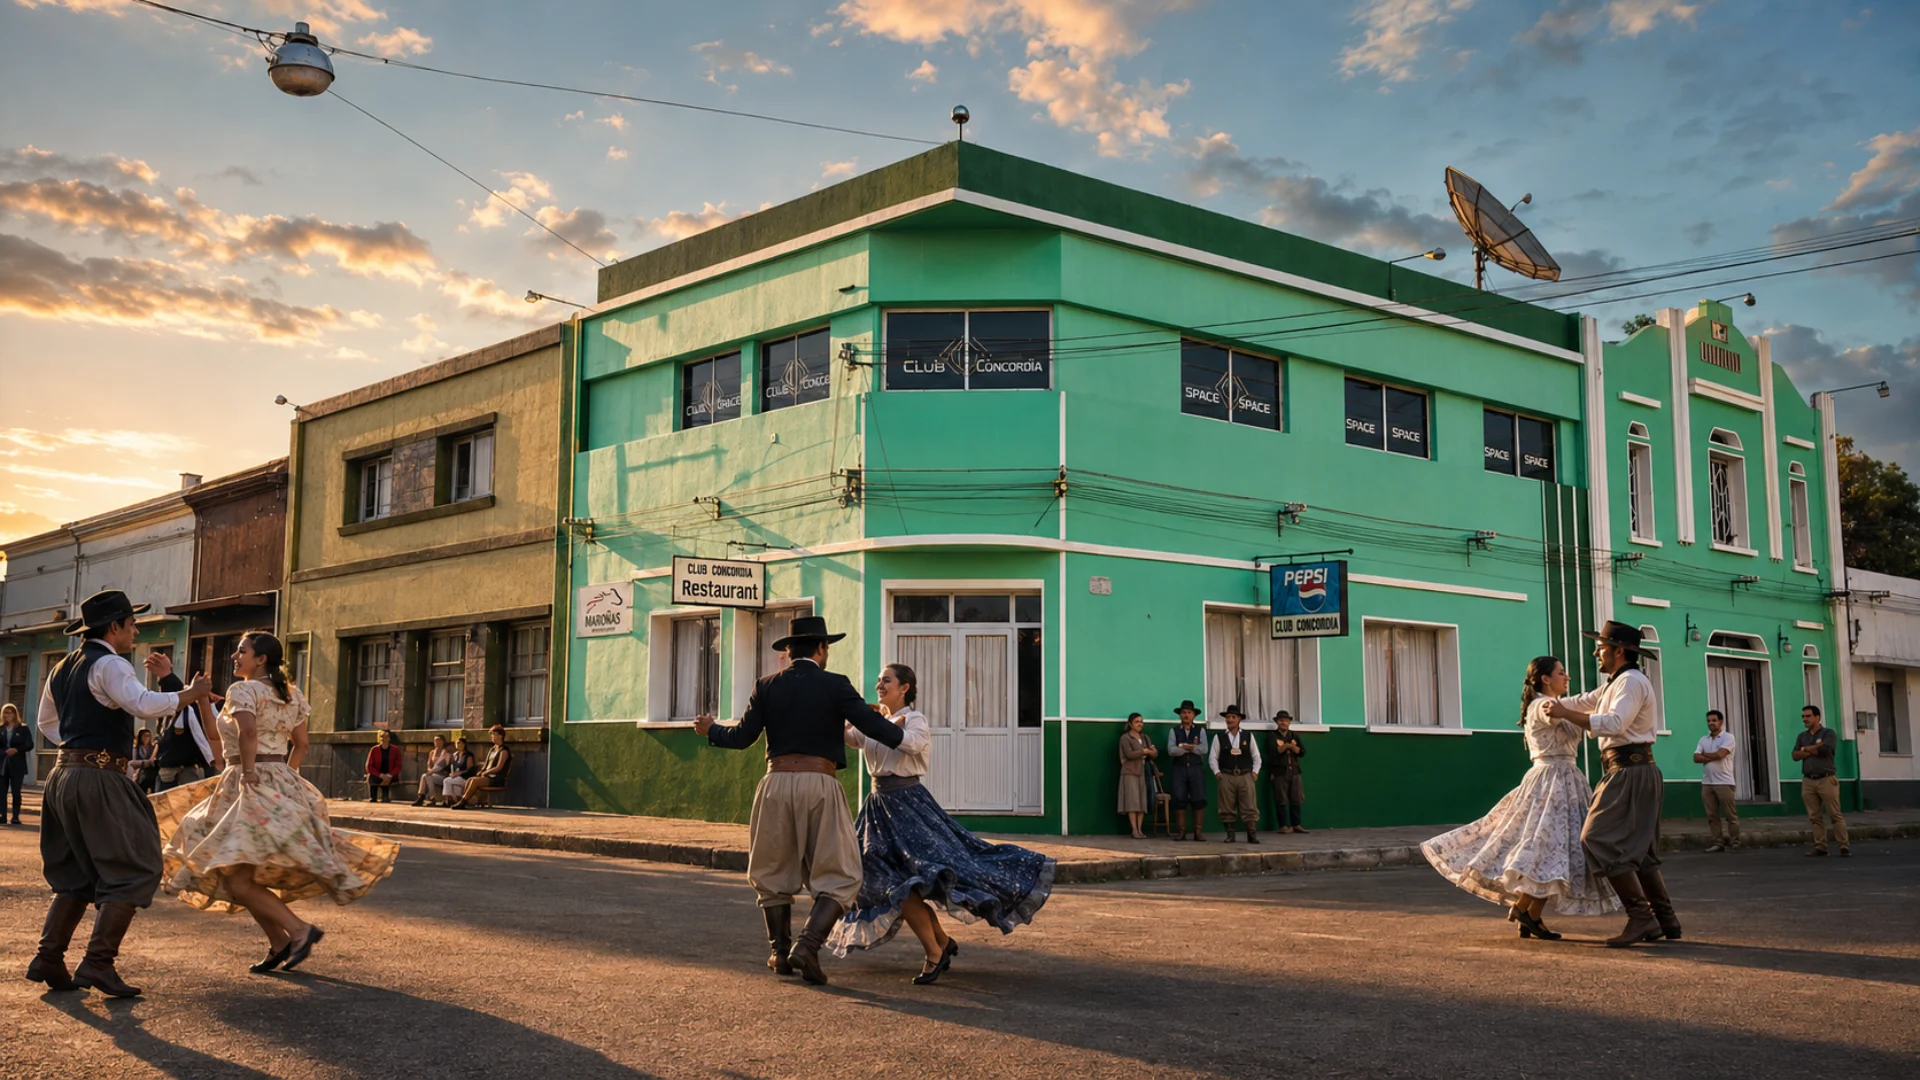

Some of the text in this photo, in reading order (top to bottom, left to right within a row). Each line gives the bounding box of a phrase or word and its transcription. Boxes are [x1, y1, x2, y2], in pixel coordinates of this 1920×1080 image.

[903, 359, 946, 373] CLUB
[1185, 387, 1271, 414] SPACE SPACE
[1346, 418, 1421, 443] SPACE SPACE
[1484, 446, 1548, 468] SPACE SPACE
[687, 563, 753, 578] CLUB CONCORDIA
[1284, 567, 1328, 586] PEPSI
[682, 579, 758, 600] Restaurant
[1275, 617, 1339, 633] CLUB CONCORDIA
